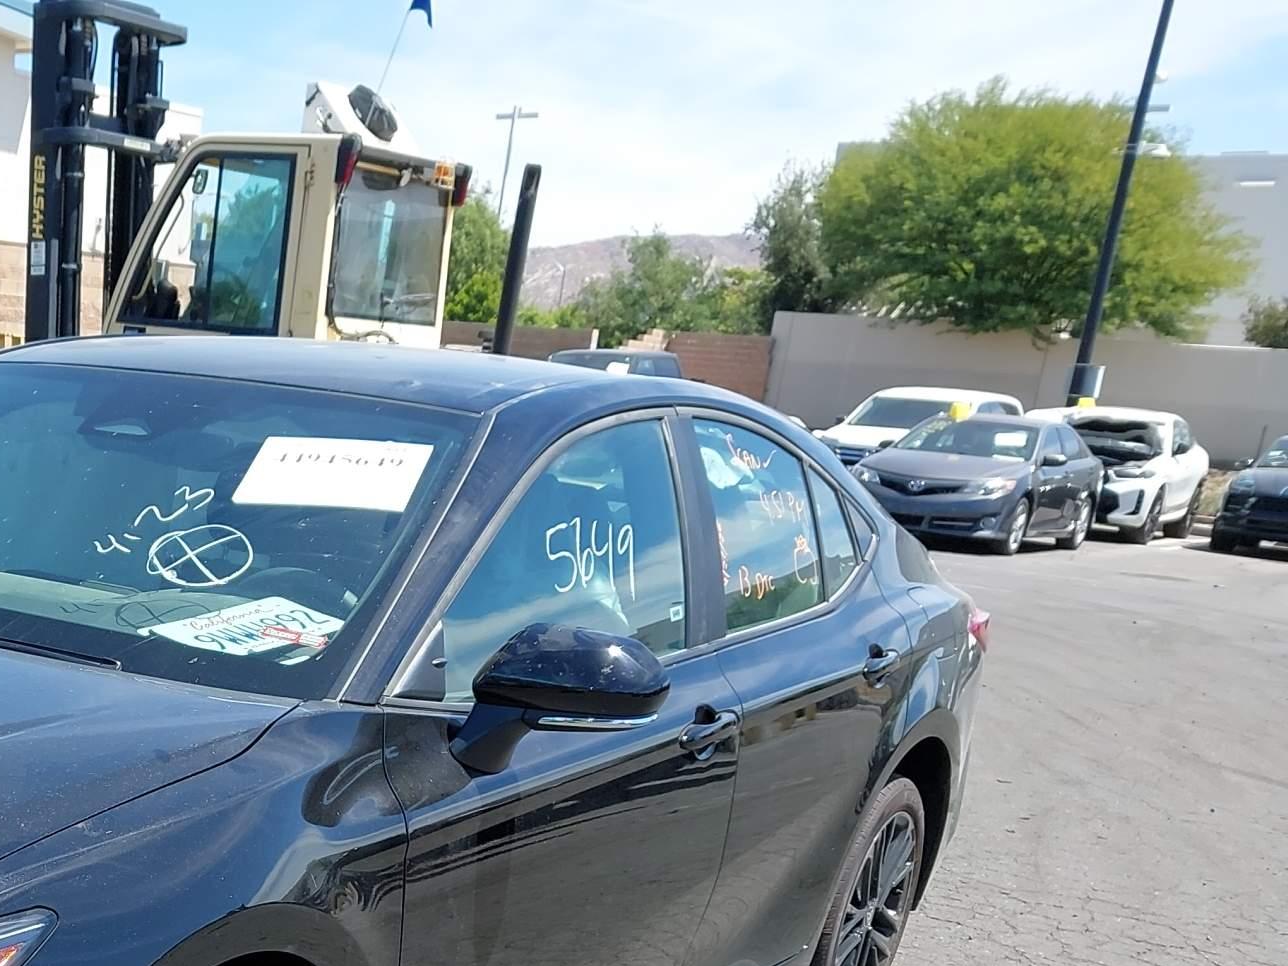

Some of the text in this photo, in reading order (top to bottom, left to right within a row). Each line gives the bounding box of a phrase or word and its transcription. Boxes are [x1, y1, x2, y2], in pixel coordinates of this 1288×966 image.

[32, 154, 46, 239] HYSTER
[545, 517, 636, 601] 5649
[190, 606, 273, 631] California
